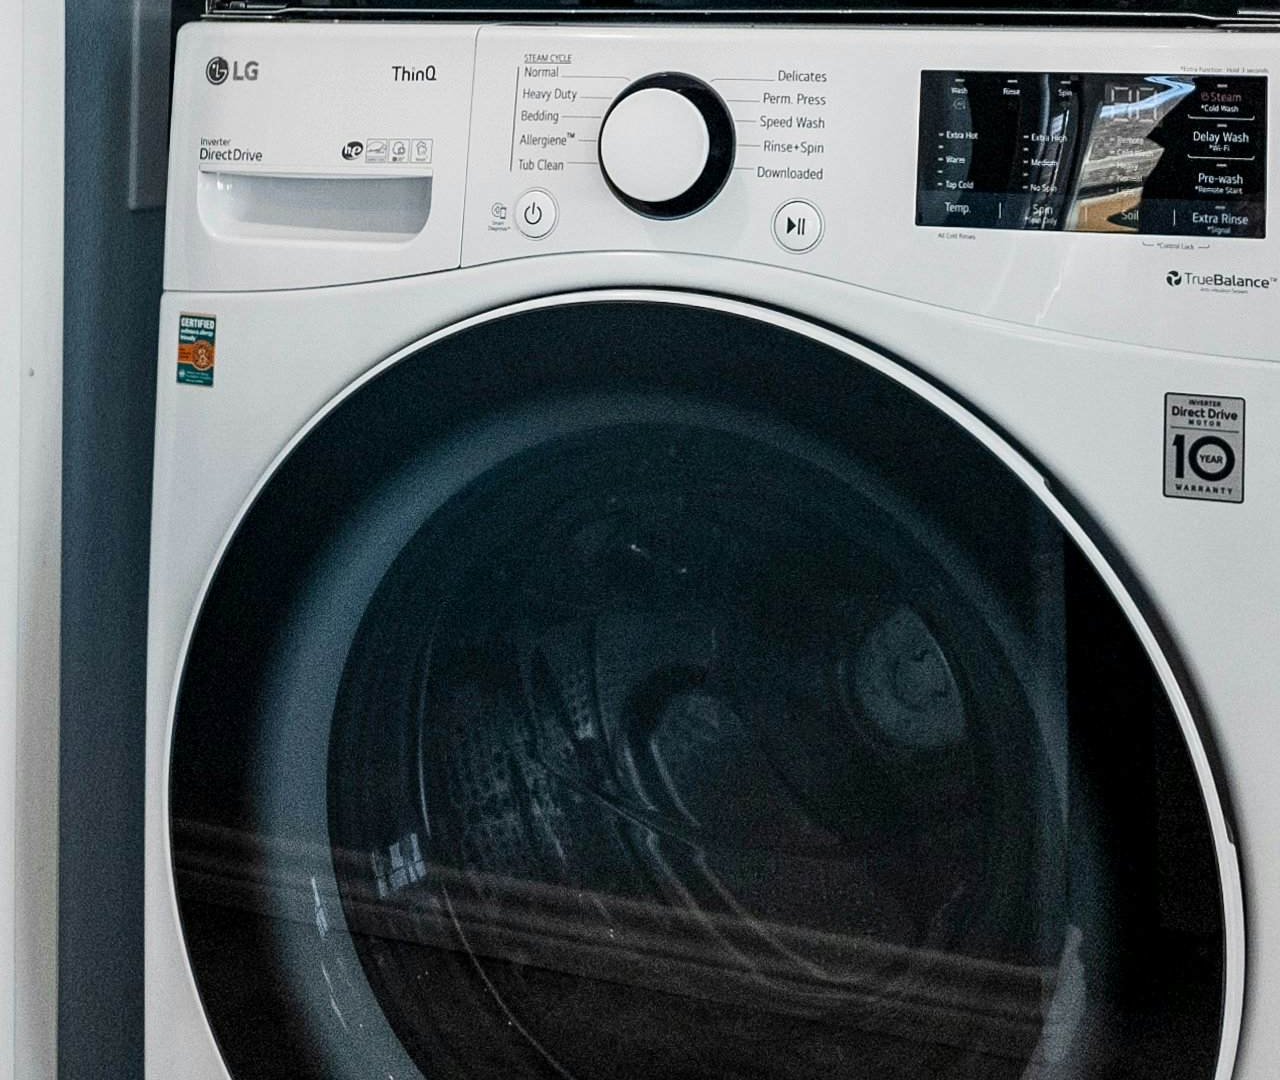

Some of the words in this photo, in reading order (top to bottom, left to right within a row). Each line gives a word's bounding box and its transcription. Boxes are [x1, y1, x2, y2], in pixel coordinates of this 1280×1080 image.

[232, 60, 259, 81] LG
[391, 65, 437, 81] ThinQ
[524, 66, 559, 77] Normal
[778, 70, 827, 82] Delicates
[522, 88, 552, 102] Heavy
[554, 88, 577, 102] Duty
[763, 92, 793, 104] Perm.
[797, 93, 826, 105] Press
[1210, 92, 1242, 103] Steam
[521, 110, 559, 124] Bedding
[760, 115, 793, 130] Speed
[796, 117, 825, 128] Wash
[946, 130, 964, 139] Extra
[1193, 131, 1220, 144] Delay
[1222, 132, 1249, 142] Wash
[200, 138, 231, 146] Inverter
[518, 159, 535, 170] Tub
[537, 159, 564, 171] Clean
[757, 166, 824, 180] Downloaded
[1198, 172, 1243, 184] Pre-wash
[945, 201, 970, 215] Temp.
[1192, 212, 1219, 224] Extra
[1221, 213, 1249, 225] Rinse
[1172, 406, 1205, 419] Direct
[1207, 408, 1238, 421] Drive
[1188, 419, 1221, 427] MOTOR
[1172, 434, 1235, 482] 10
[1200, 454, 1223, 464] YEAR
[1175, 483, 1233, 495] WARRANTY
